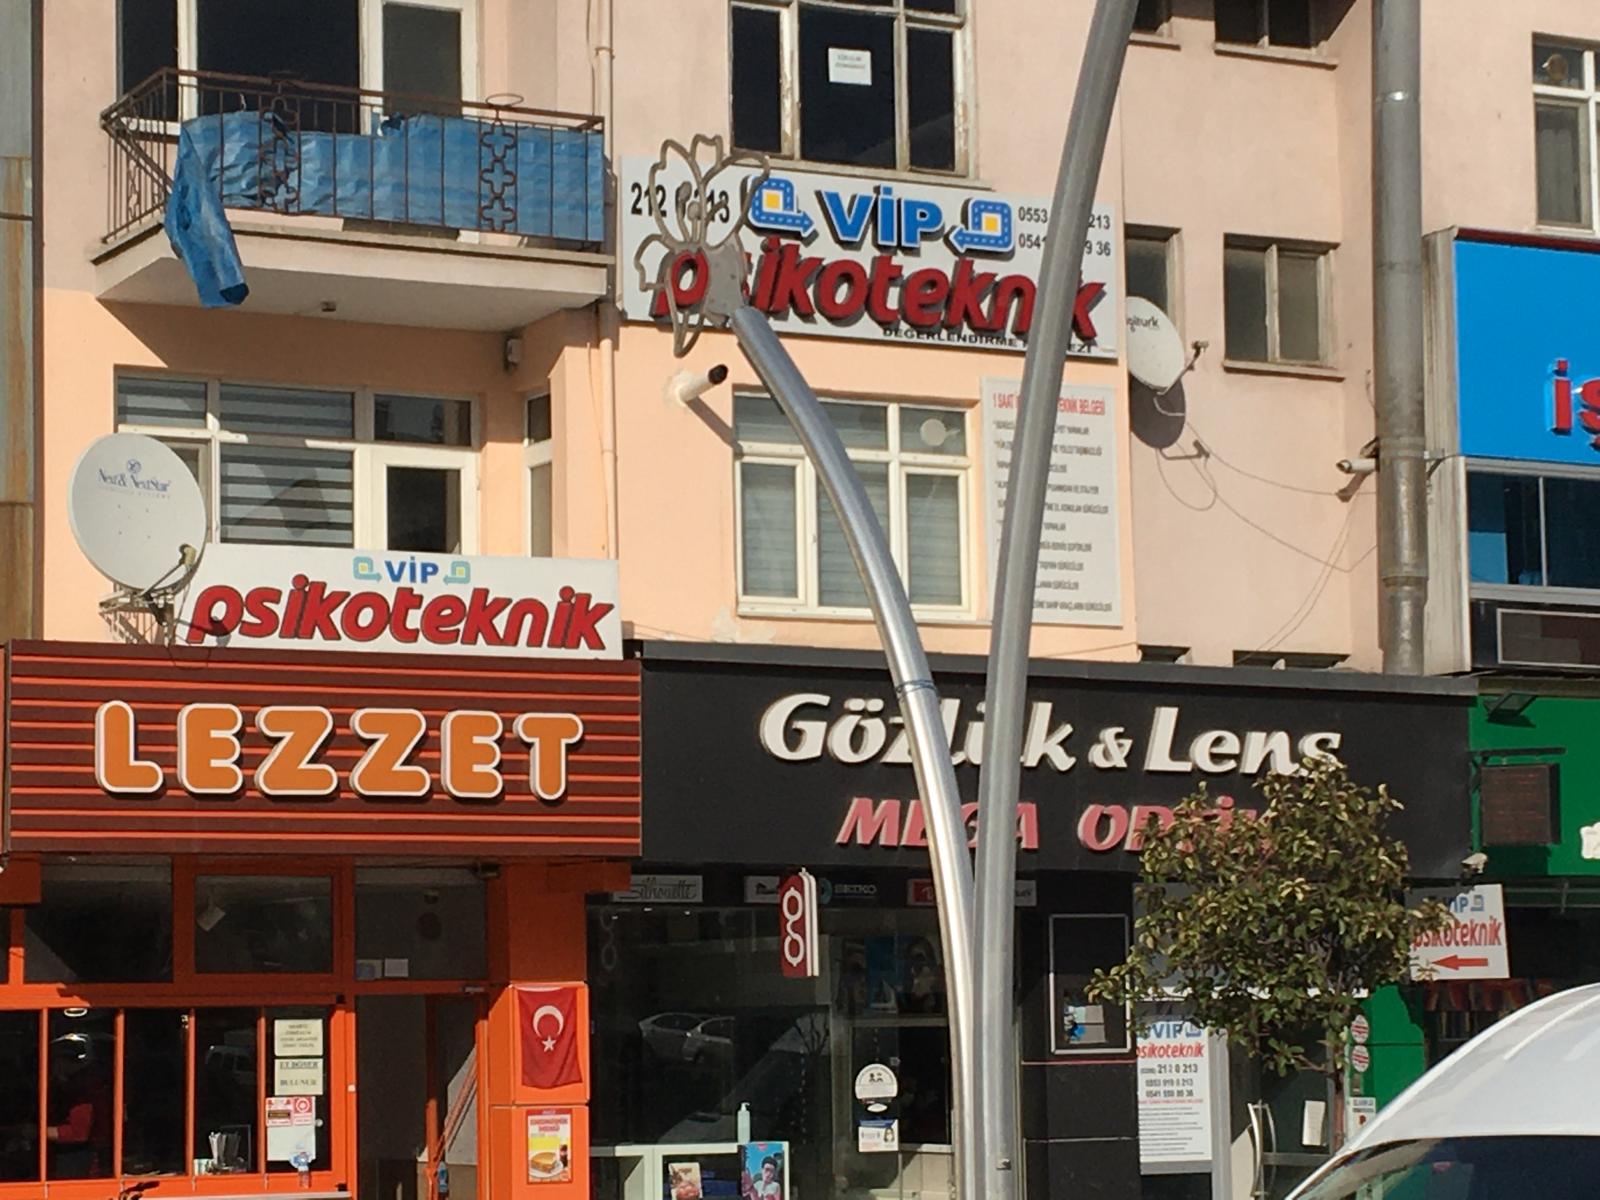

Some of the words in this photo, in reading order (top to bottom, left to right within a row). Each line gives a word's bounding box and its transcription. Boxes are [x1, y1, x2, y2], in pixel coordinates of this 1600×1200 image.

[631, 182, 667, 217] 212
[820, 184, 945, 248] VİP
[1018, 206, 1048, 223] 0553
[1096, 241, 1111, 256] 36
[653, 235, 1106, 338] pikoteknk
[384, 555, 440, 584] VİP
[186, 573, 615, 652] psikoteknik
[95, 700, 585, 802] LEZZET
[1088, 727, 1133, 769] &
[1143, 707, 1342, 776] Lens
